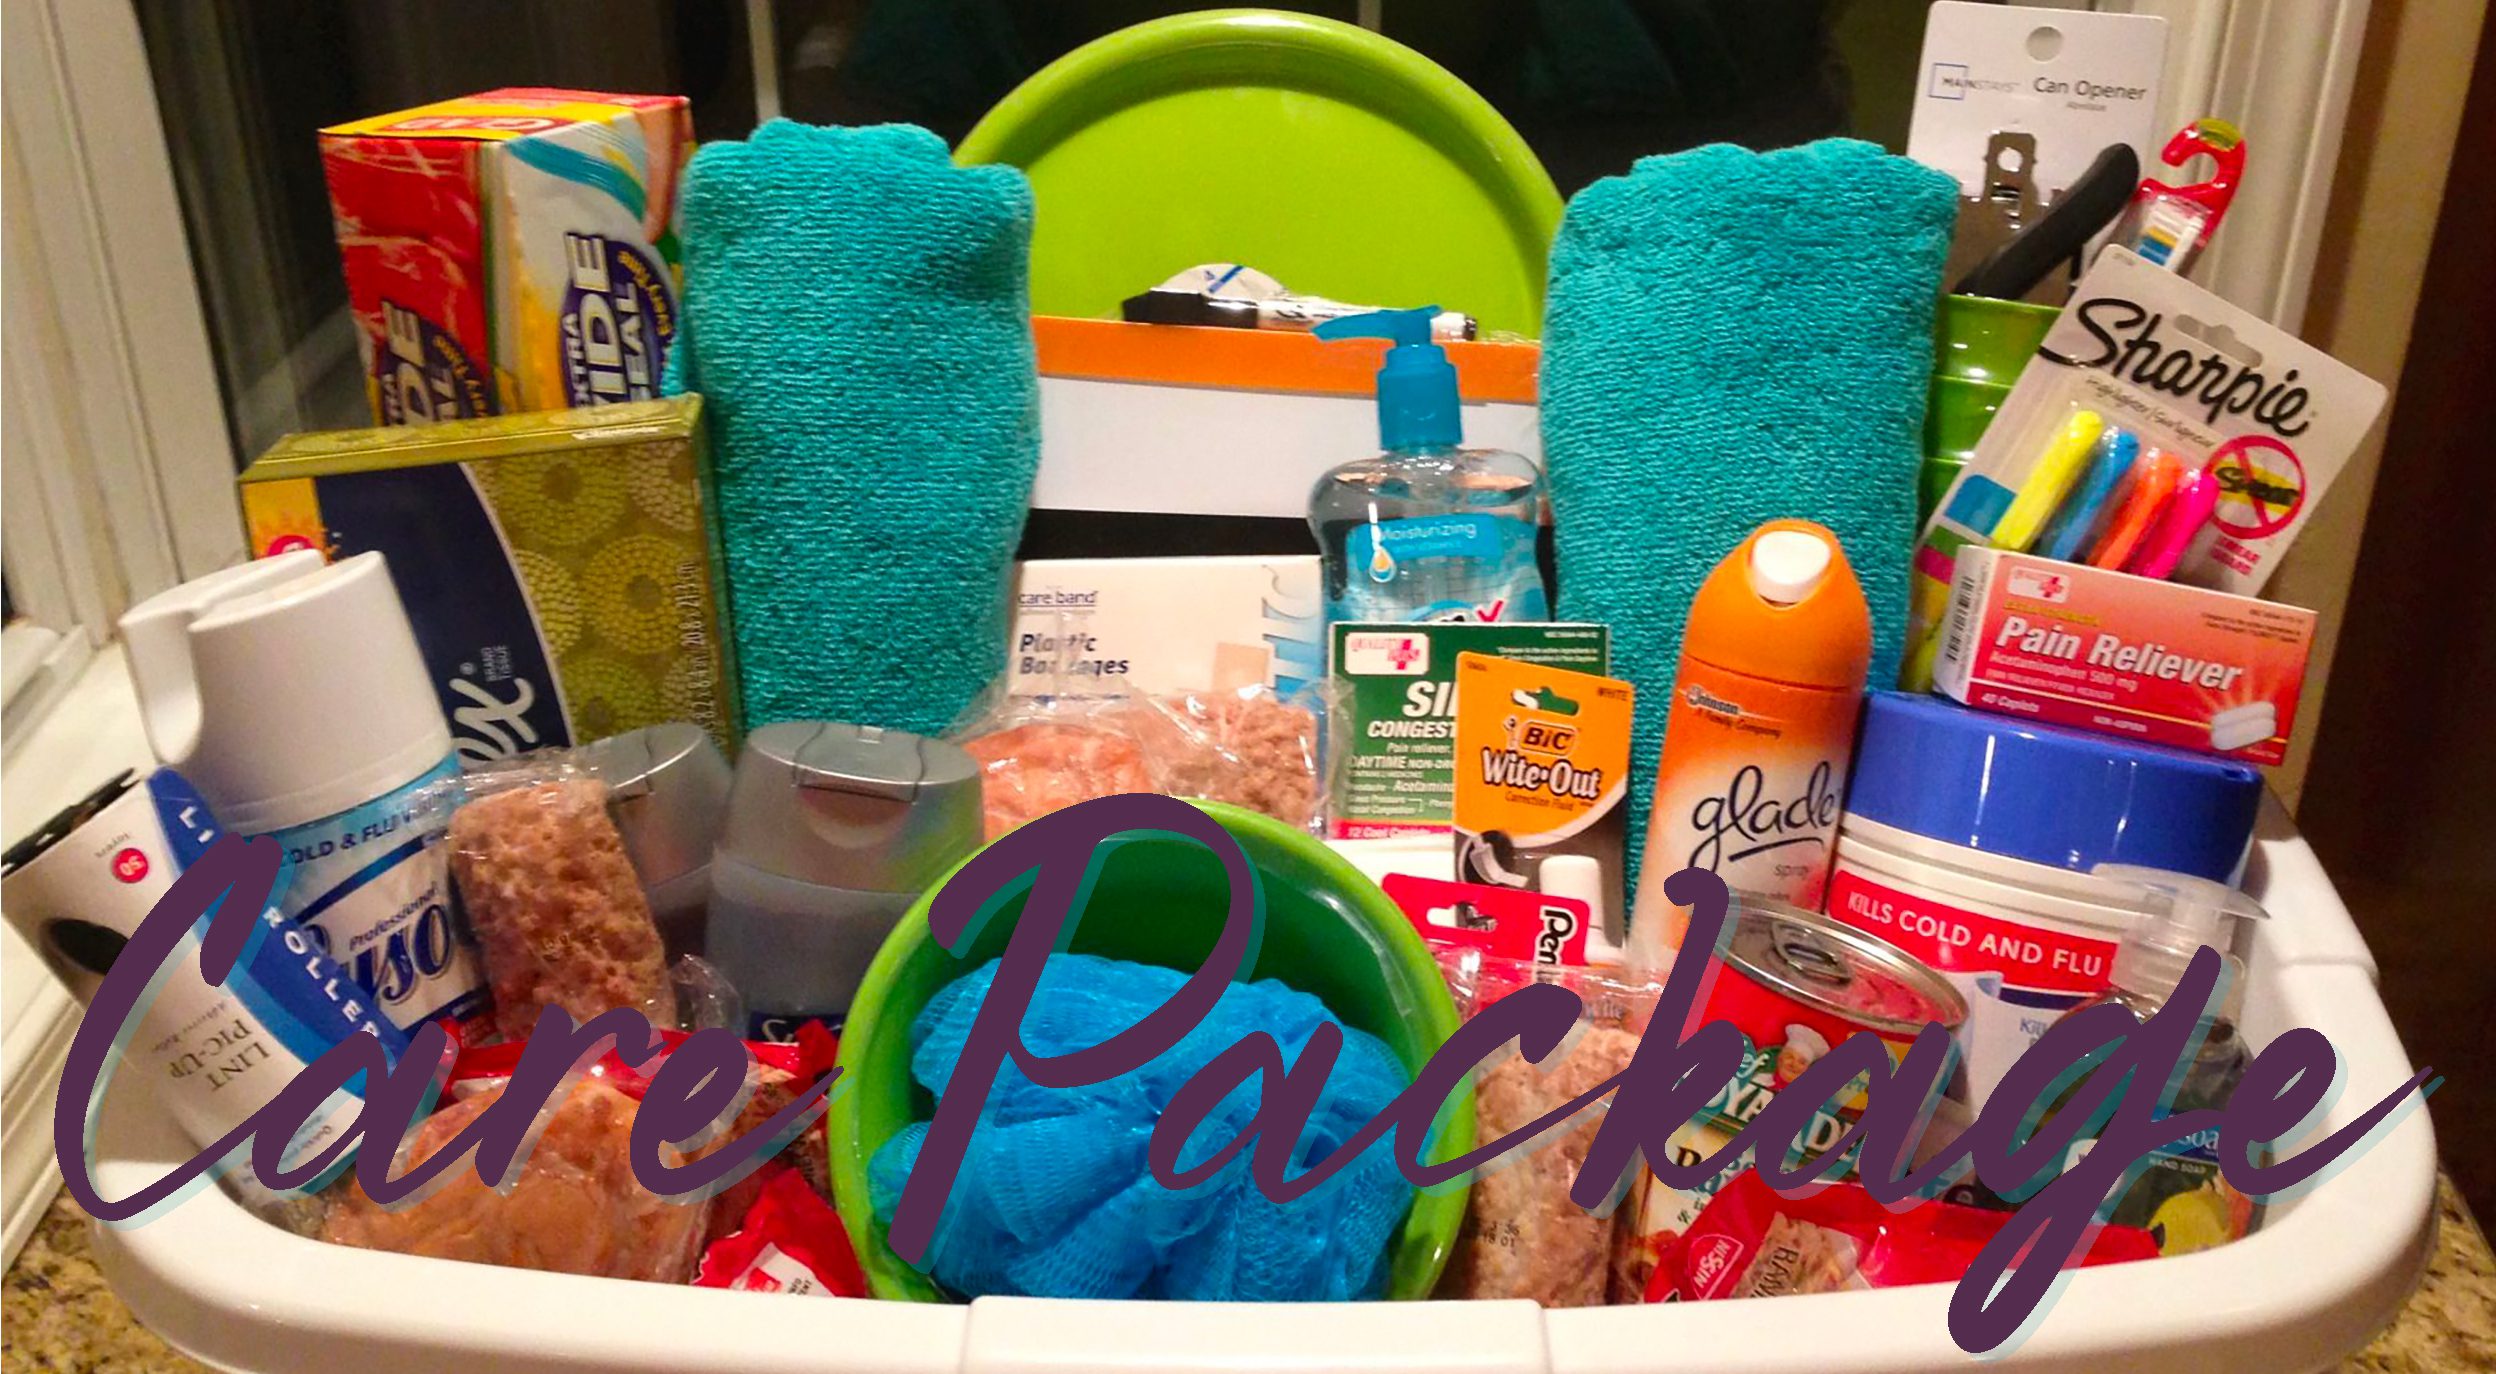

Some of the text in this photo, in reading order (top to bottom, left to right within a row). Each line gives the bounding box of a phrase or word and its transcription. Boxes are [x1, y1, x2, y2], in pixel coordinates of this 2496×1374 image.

[2033, 77, 2069, 94] Can
[2074, 80, 2147, 100] Opener
[564, 231, 623, 408] IDE
[2038, 298, 2310, 436] Sharpie
[1018, 590, 1098, 605] care band
[1995, 615, 2082, 661] Pain
[2086, 632, 2245, 692] Reliever
[1402, 680, 1457, 718] SI
[340, 832, 357, 851] &
[1687, 761, 1837, 872] glade
[1847, 889, 2103, 977] KILLS COLD AND FLU
[168, 1017, 253, 1080] PIC-UP
[208, 1042, 271, 1092] LINT
[1692, 1238, 1732, 1289] NISSIN
